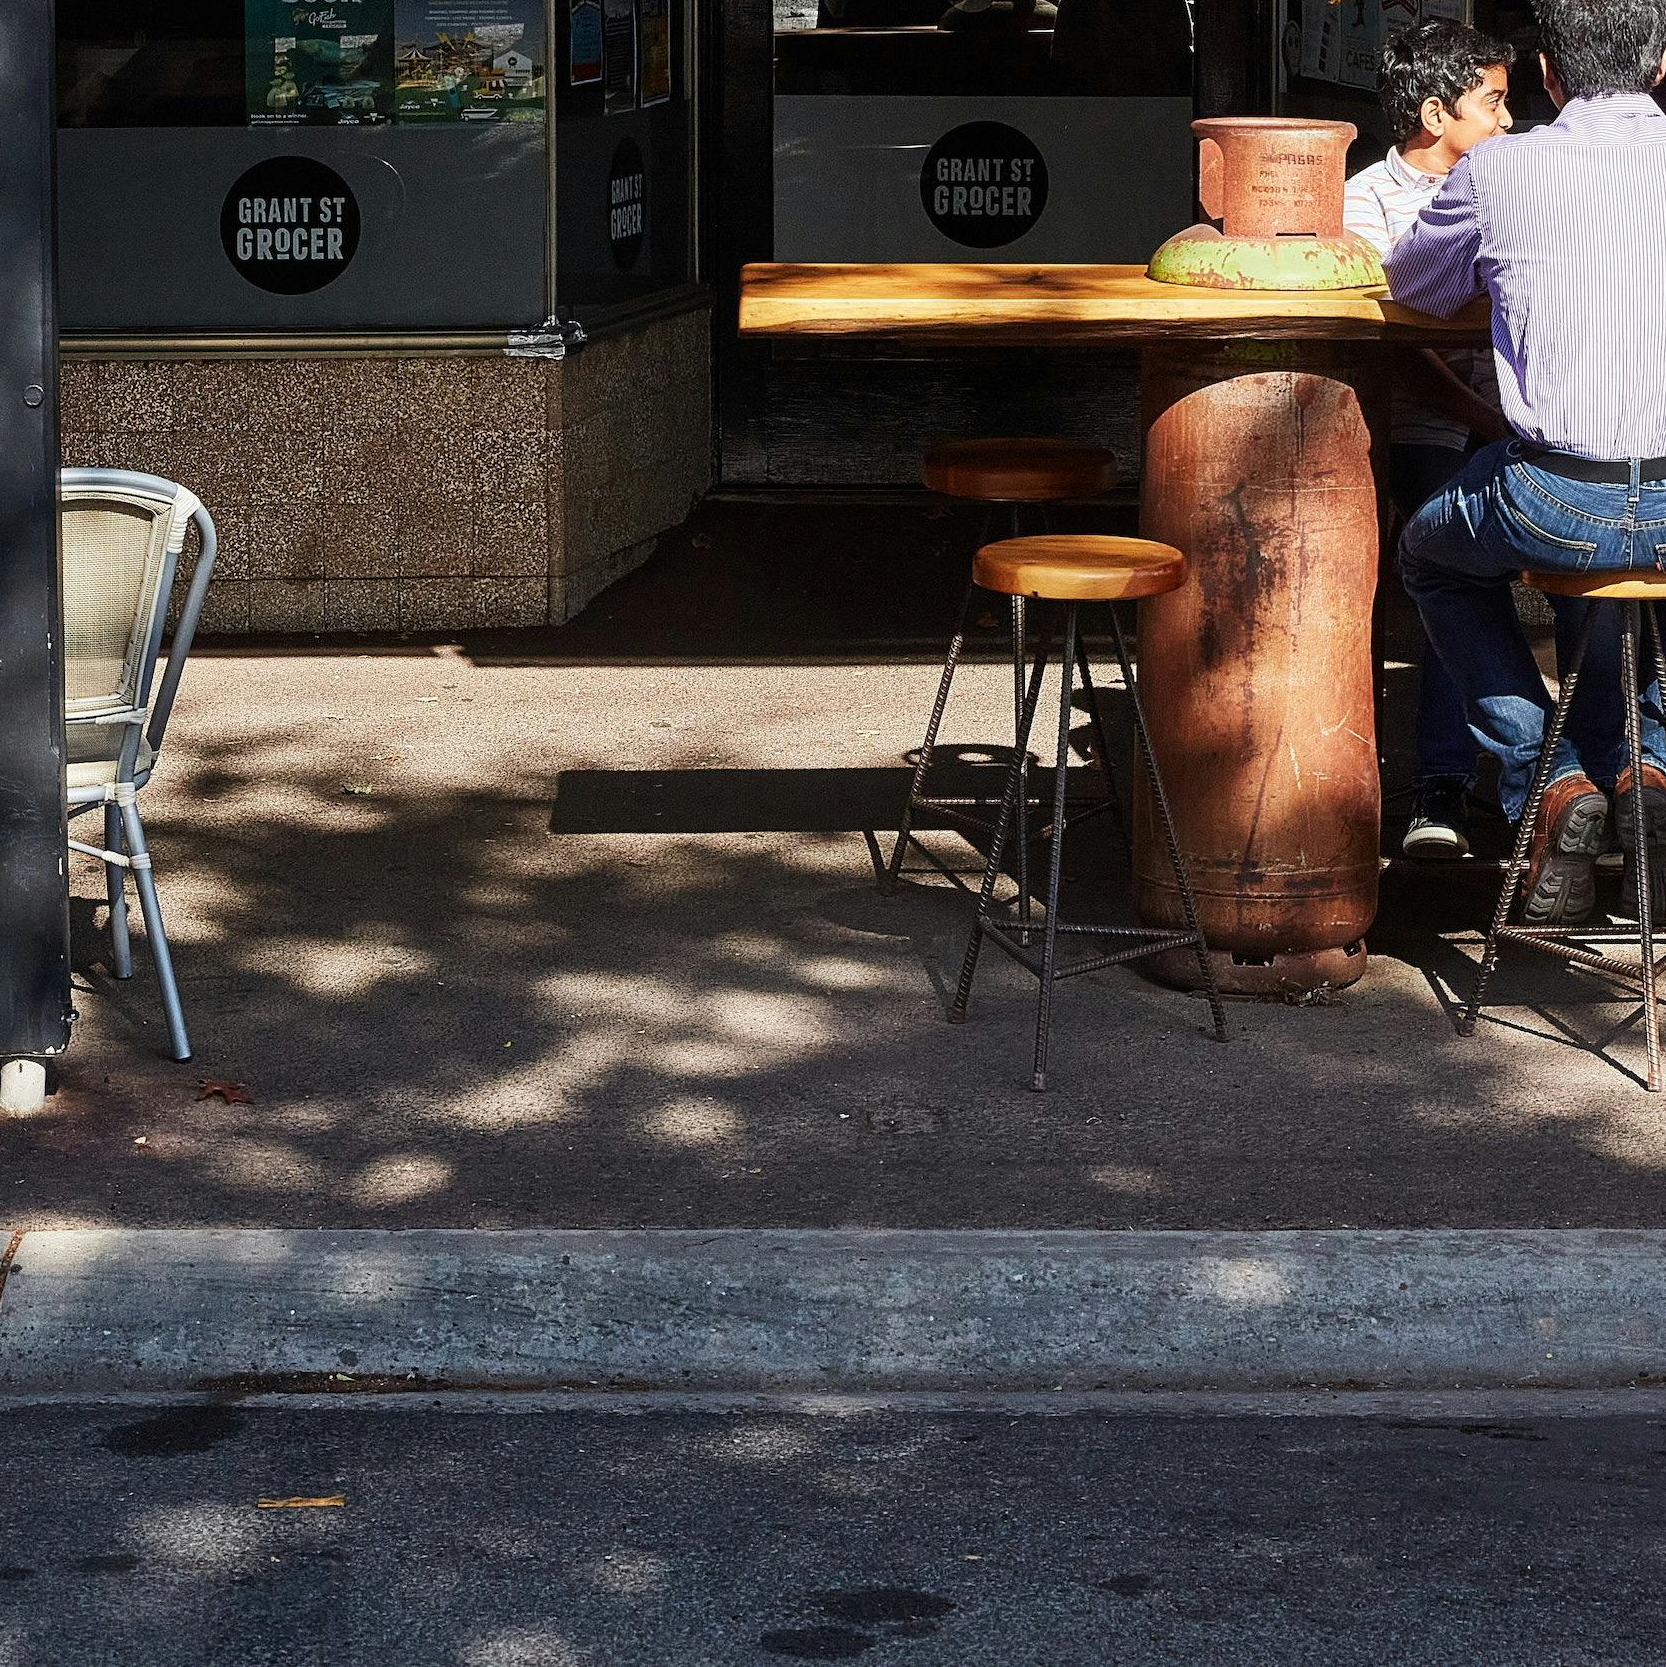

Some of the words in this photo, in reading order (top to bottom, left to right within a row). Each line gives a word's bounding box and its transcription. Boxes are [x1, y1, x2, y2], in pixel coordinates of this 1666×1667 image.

[936, 158, 1004, 182] GRANT
[1010, 158, 1035, 182] ST
[238, 197, 310, 224] GRANT
[319, 197, 346, 224] ST
[934, 185, 1033, 216] GROCER
[610, 202, 643, 240] GROCER
[236, 227, 344, 261] GROCER
